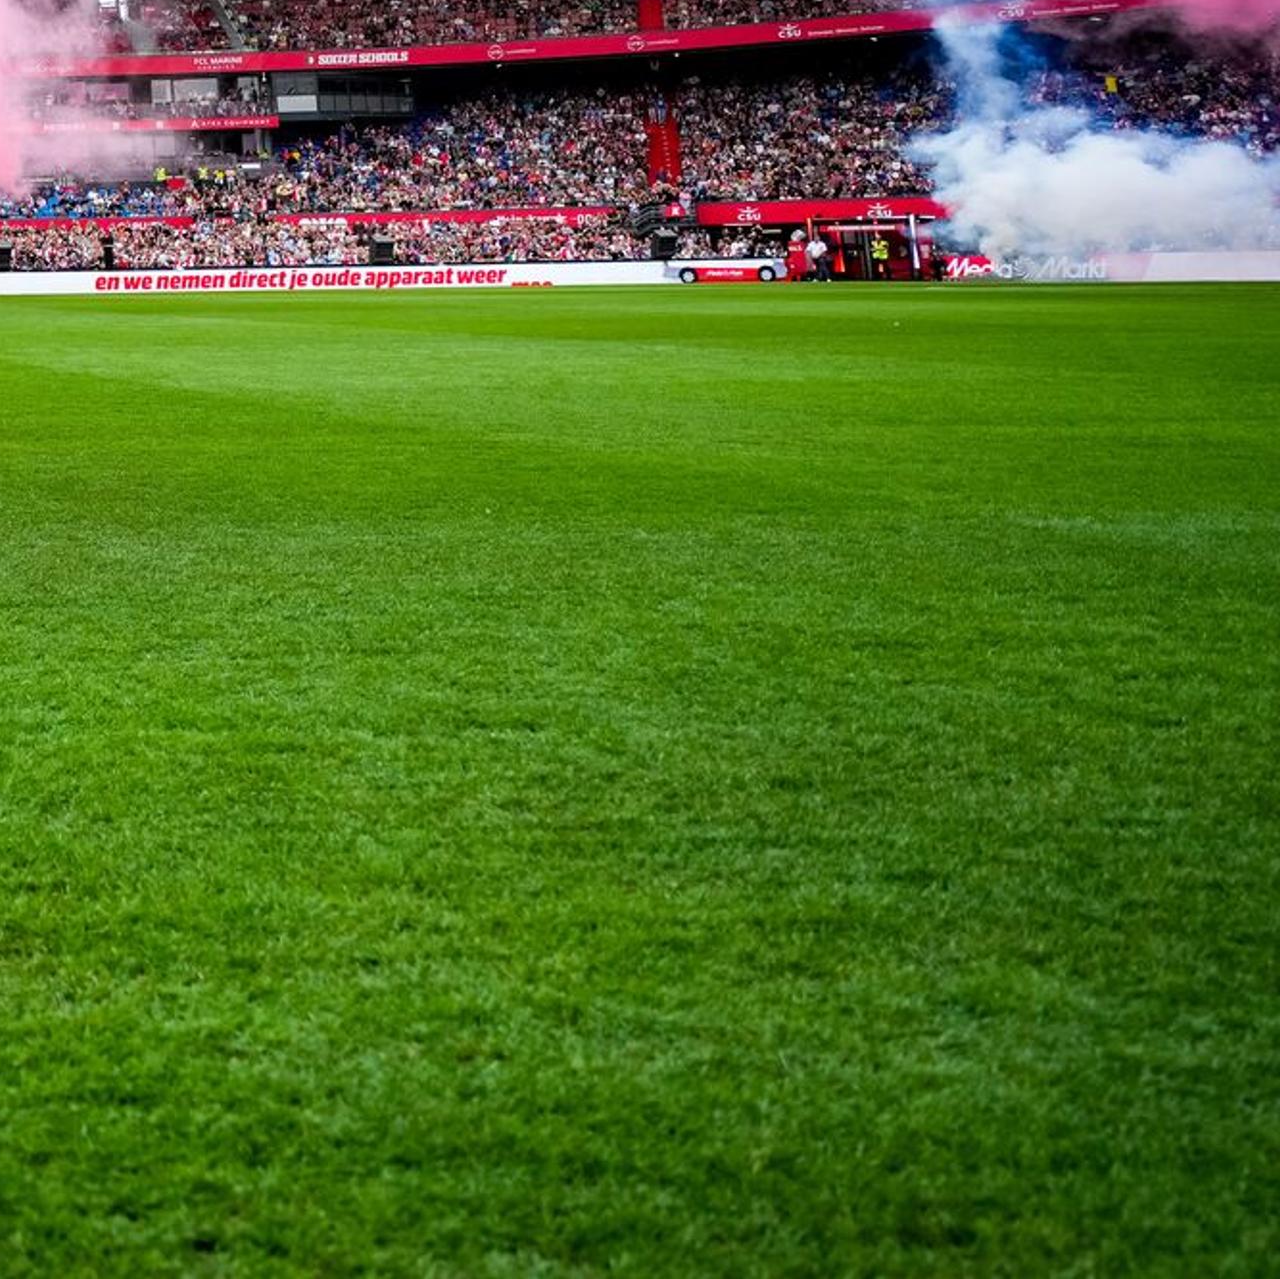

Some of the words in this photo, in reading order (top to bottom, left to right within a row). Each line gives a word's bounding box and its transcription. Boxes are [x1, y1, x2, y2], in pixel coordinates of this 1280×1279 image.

[778, 28, 801, 39] CSU
[318, 53, 357, 66] SOCCER
[358, 51, 408, 64] SCHOOLS
[737, 210, 761, 221] CSU
[95, 275, 119, 290] en
[124, 275, 153, 290] we
[157, 274, 226, 289] nemen
[229, 270, 287, 288] direct
[289, 270, 308, 290] je
[311, 270, 360, 287] oude
[364, 268, 453, 289] apparaat
[457, 268, 507, 284] weer
